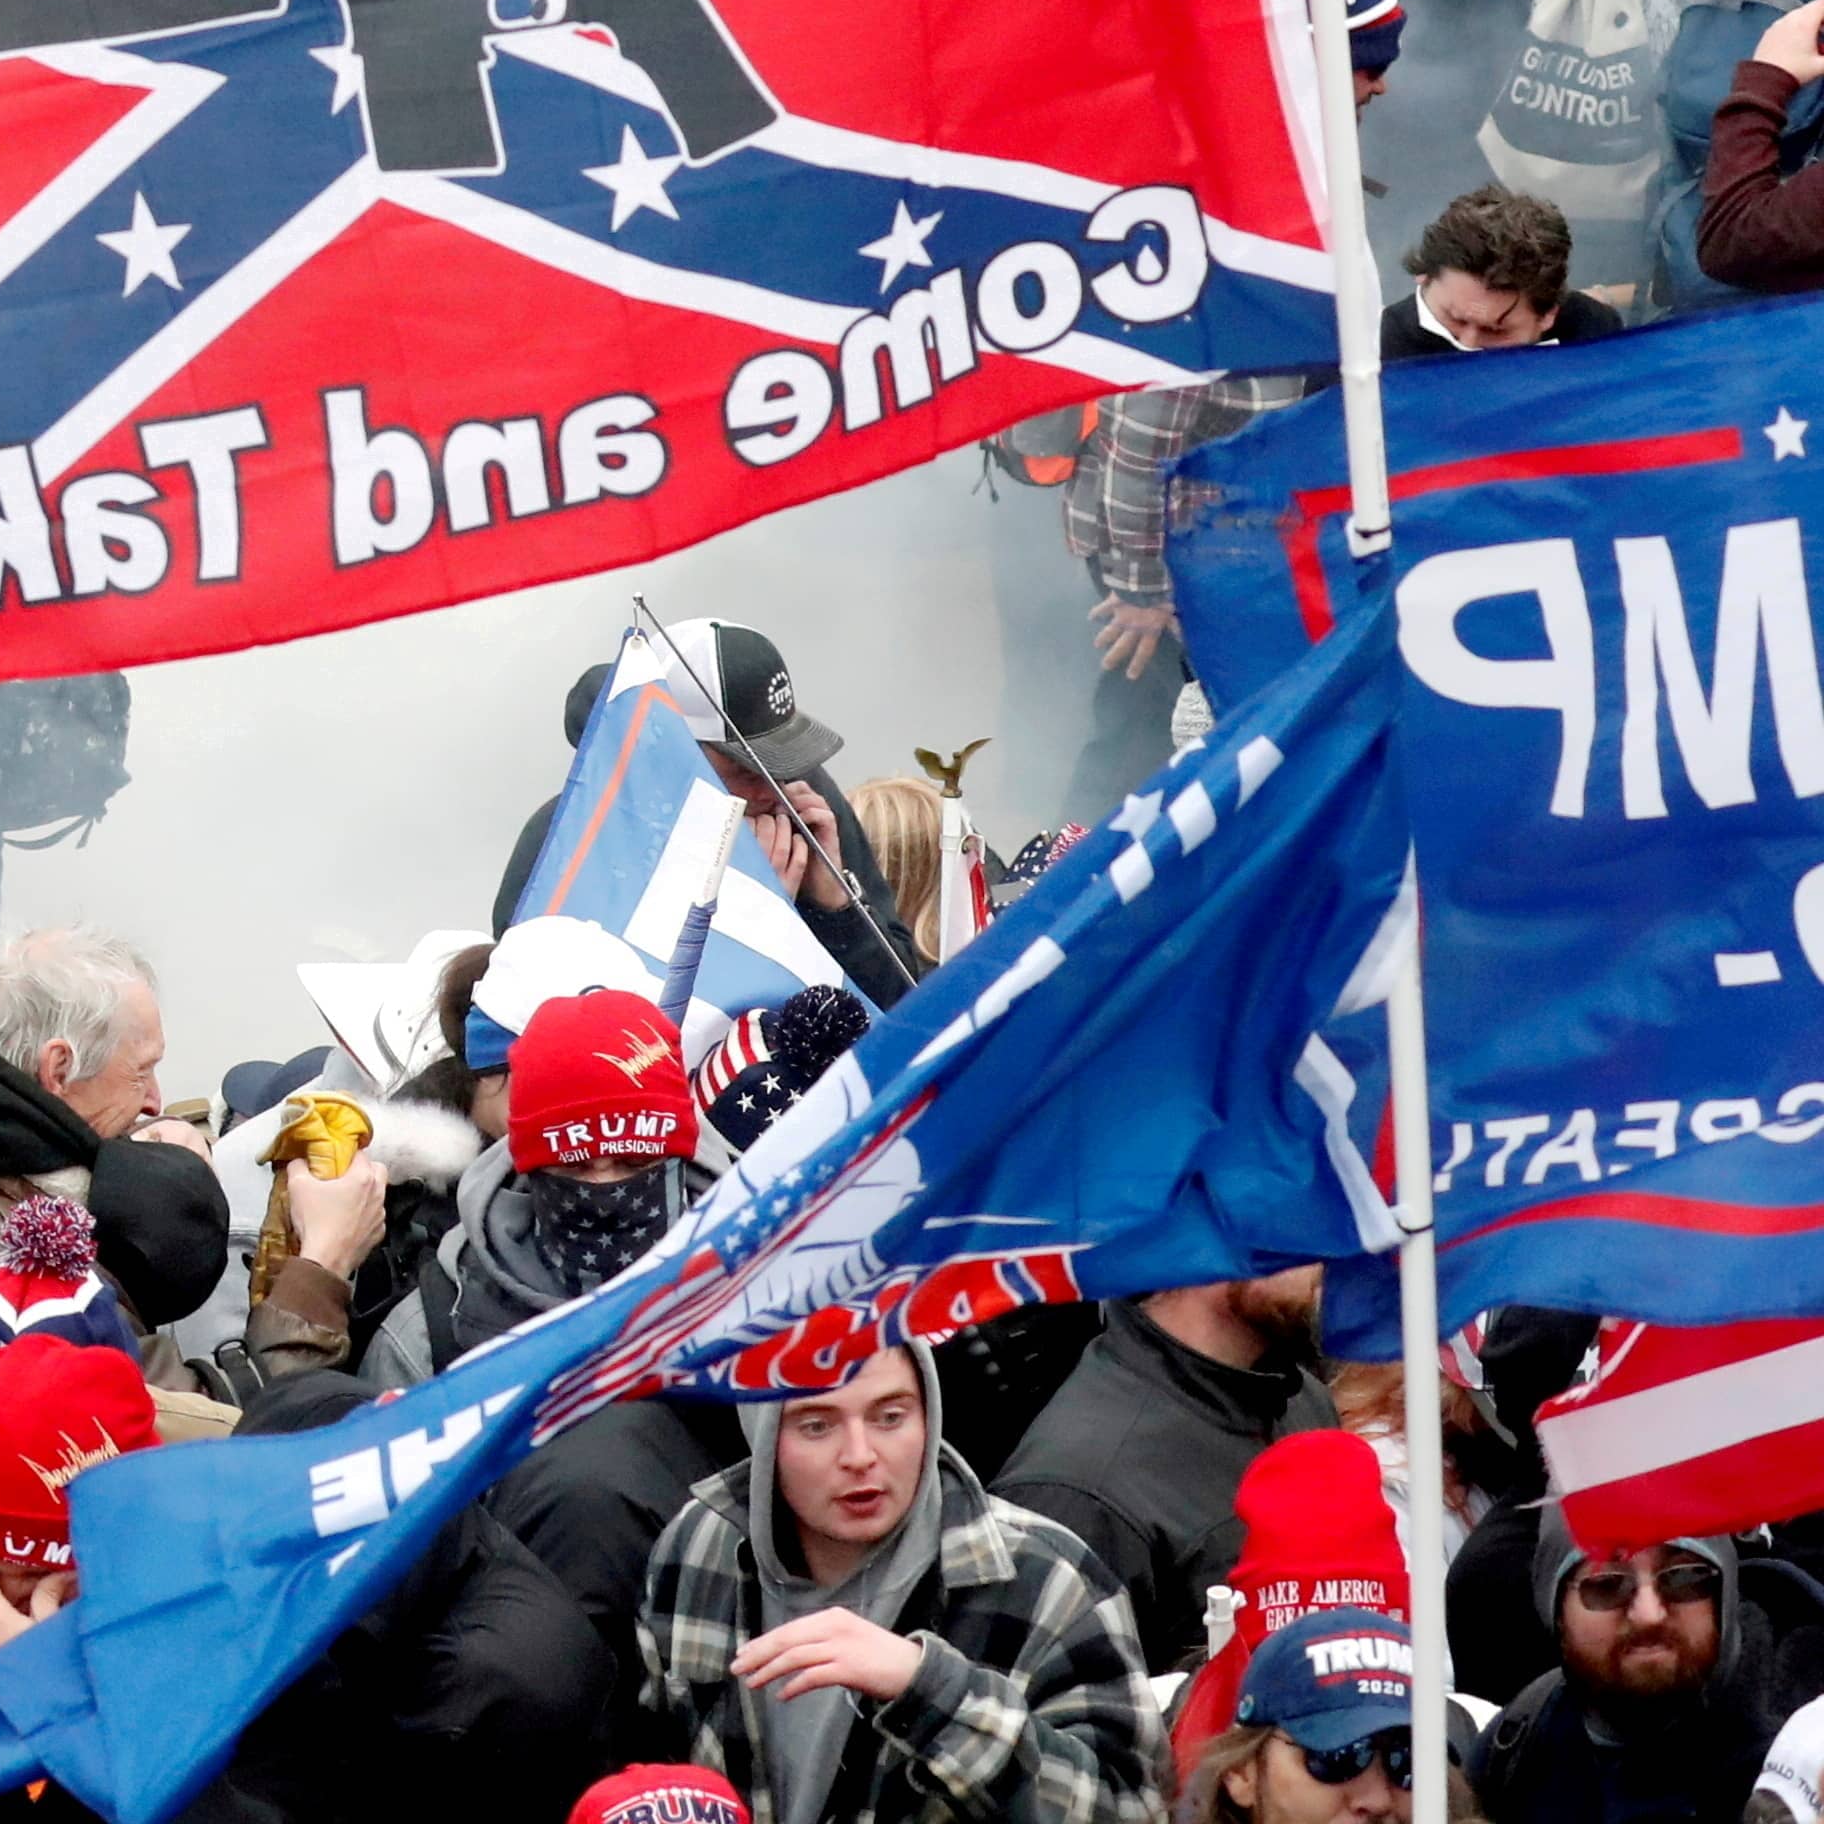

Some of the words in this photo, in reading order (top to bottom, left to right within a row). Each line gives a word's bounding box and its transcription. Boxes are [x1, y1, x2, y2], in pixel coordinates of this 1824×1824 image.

[1509, 76, 1642, 127] CONTROL
[542, 1115, 677, 1154] TRUMP
[558, 1147, 591, 1164] 45TH
[599, 1139, 667, 1156] PRESIDENT
[1257, 1580, 1300, 1611] MAKE
[1311, 1579, 1386, 1604] AMERICA
[1304, 1637, 1413, 1677] TRUM
[1357, 1679, 1405, 1697] 2020
